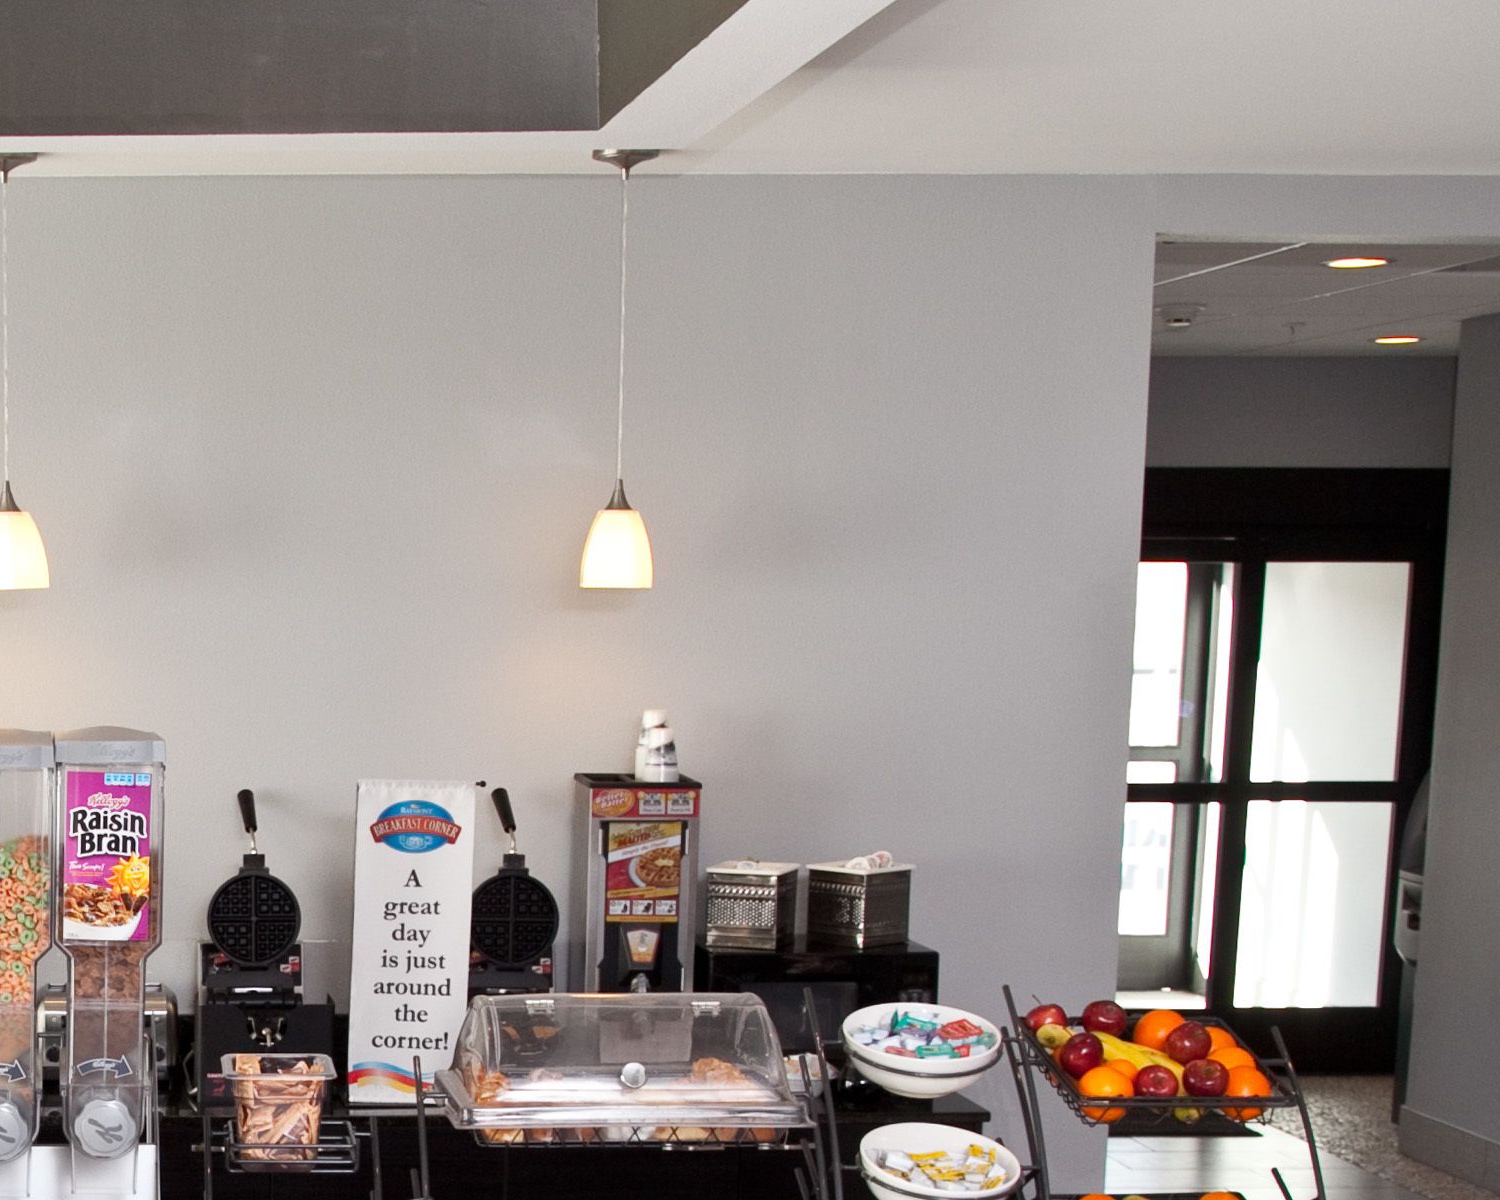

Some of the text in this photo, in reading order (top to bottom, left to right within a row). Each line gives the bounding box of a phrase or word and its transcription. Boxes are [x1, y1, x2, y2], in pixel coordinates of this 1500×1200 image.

[73, 809, 145, 836] Raisin
[373, 818, 458, 839] BREAKFAST CORNER
[80, 832, 136, 854] Bran
[404, 869, 422, 888] A
[383, 900, 441, 920] great
[392, 924, 431, 947] day
[381, 950, 446, 973] is just
[373, 978, 451, 997] around
[394, 1004, 428, 1023] the
[371, 1032, 449, 1051] corner!
